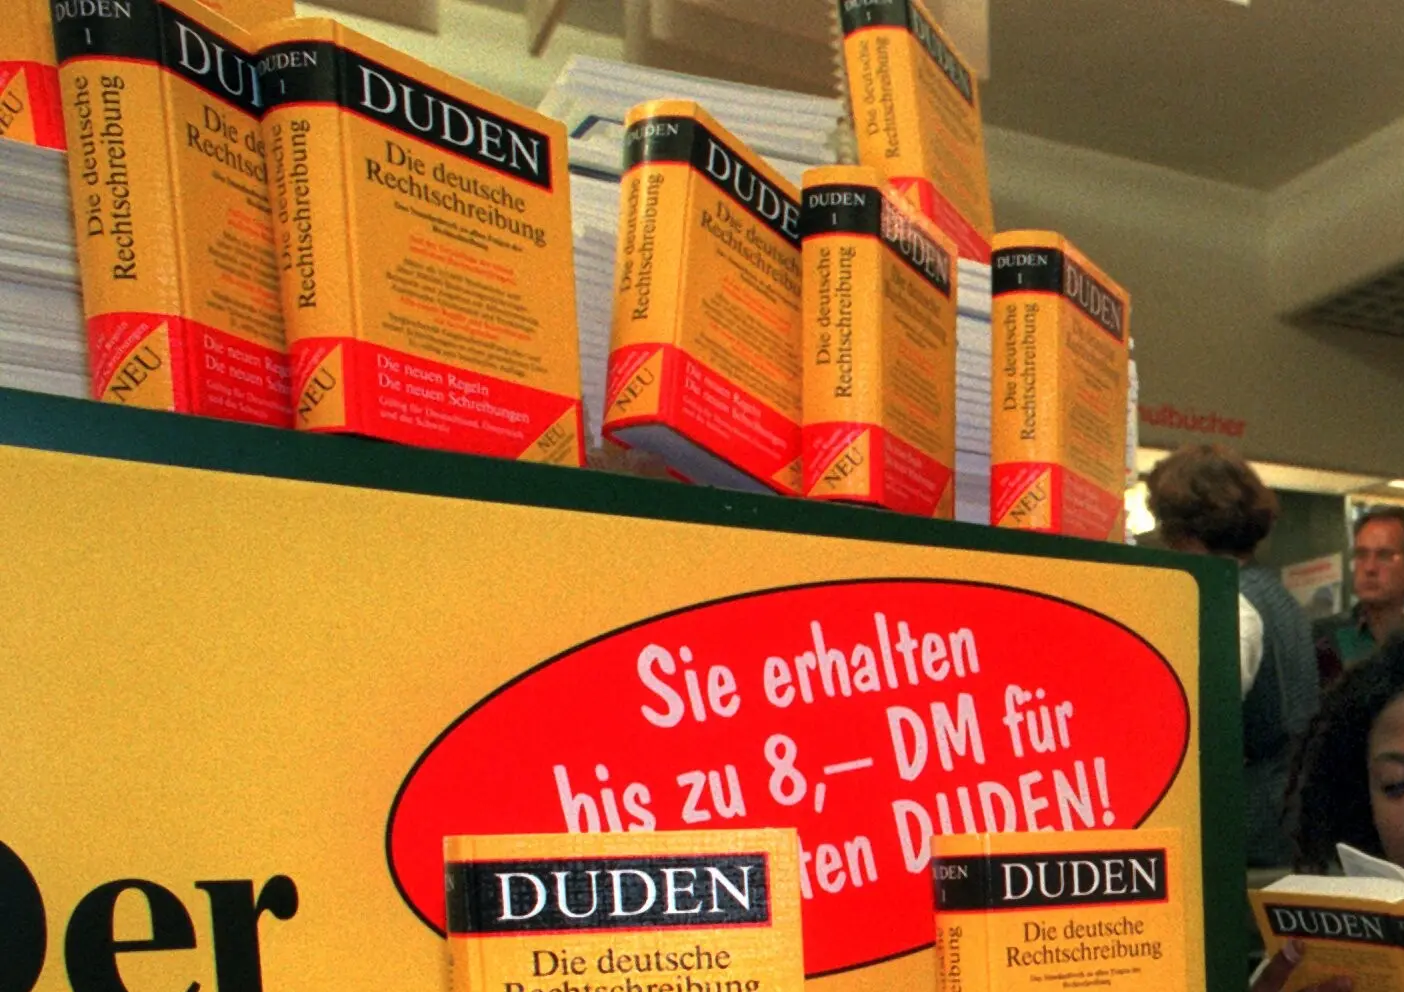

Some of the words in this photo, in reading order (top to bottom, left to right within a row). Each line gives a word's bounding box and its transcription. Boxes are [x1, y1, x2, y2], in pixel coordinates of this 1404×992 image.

[74, 75, 99, 186] deutsche
[358, 64, 540, 176] DUDEN
[876, 36, 900, 158] Rechtschreibung
[99, 75, 137, 281] Rechtschreibung
[366, 158, 547, 248] Rechtschreibung
[386, 140, 426, 176] Die
[432, 163, 526, 213] deutsche
[809, 192, 866, 208] DUDEN
[87, 192, 105, 236] Die
[290, 119, 317, 310] Rechtschreibung
[632, 172, 664, 321] Rechtschreibung
[816, 248, 832, 328] deutsche
[996, 253, 1048, 269] DUDEN
[835, 246, 856, 398] Rechtschreibung
[1065, 266, 1122, 330] DUDEN
[110, 346, 162, 401] NEU
[816, 332, 832, 365] Die
[1003, 304, 1017, 377] deutsche
[1020, 302, 1040, 440] Rechtschreibung
[448, 374, 489, 396] Regeln
[824, 448, 865, 489] NEU
[637, 642, 742, 729] Sie
[763, 612, 981, 709] erhalten
[553, 763, 658, 834] bis
[676, 768, 744, 826] zu
[887, 693, 989, 782] DM
[1001, 684, 1075, 756] für
[891, 755, 1119, 876] DUDEN!
[494, 865, 755, 921] DUDEN
[1002, 857, 1158, 901] DUDEN
[1006, 939, 1163, 968] Rechtschreibung
[1022, 920, 1058, 943] Die
[1062, 916, 1144, 939] deutsche
[1274, 908, 1385, 939] DUDEN
[532, 949, 588, 978] Die
[597, 944, 732, 975] deutsche
